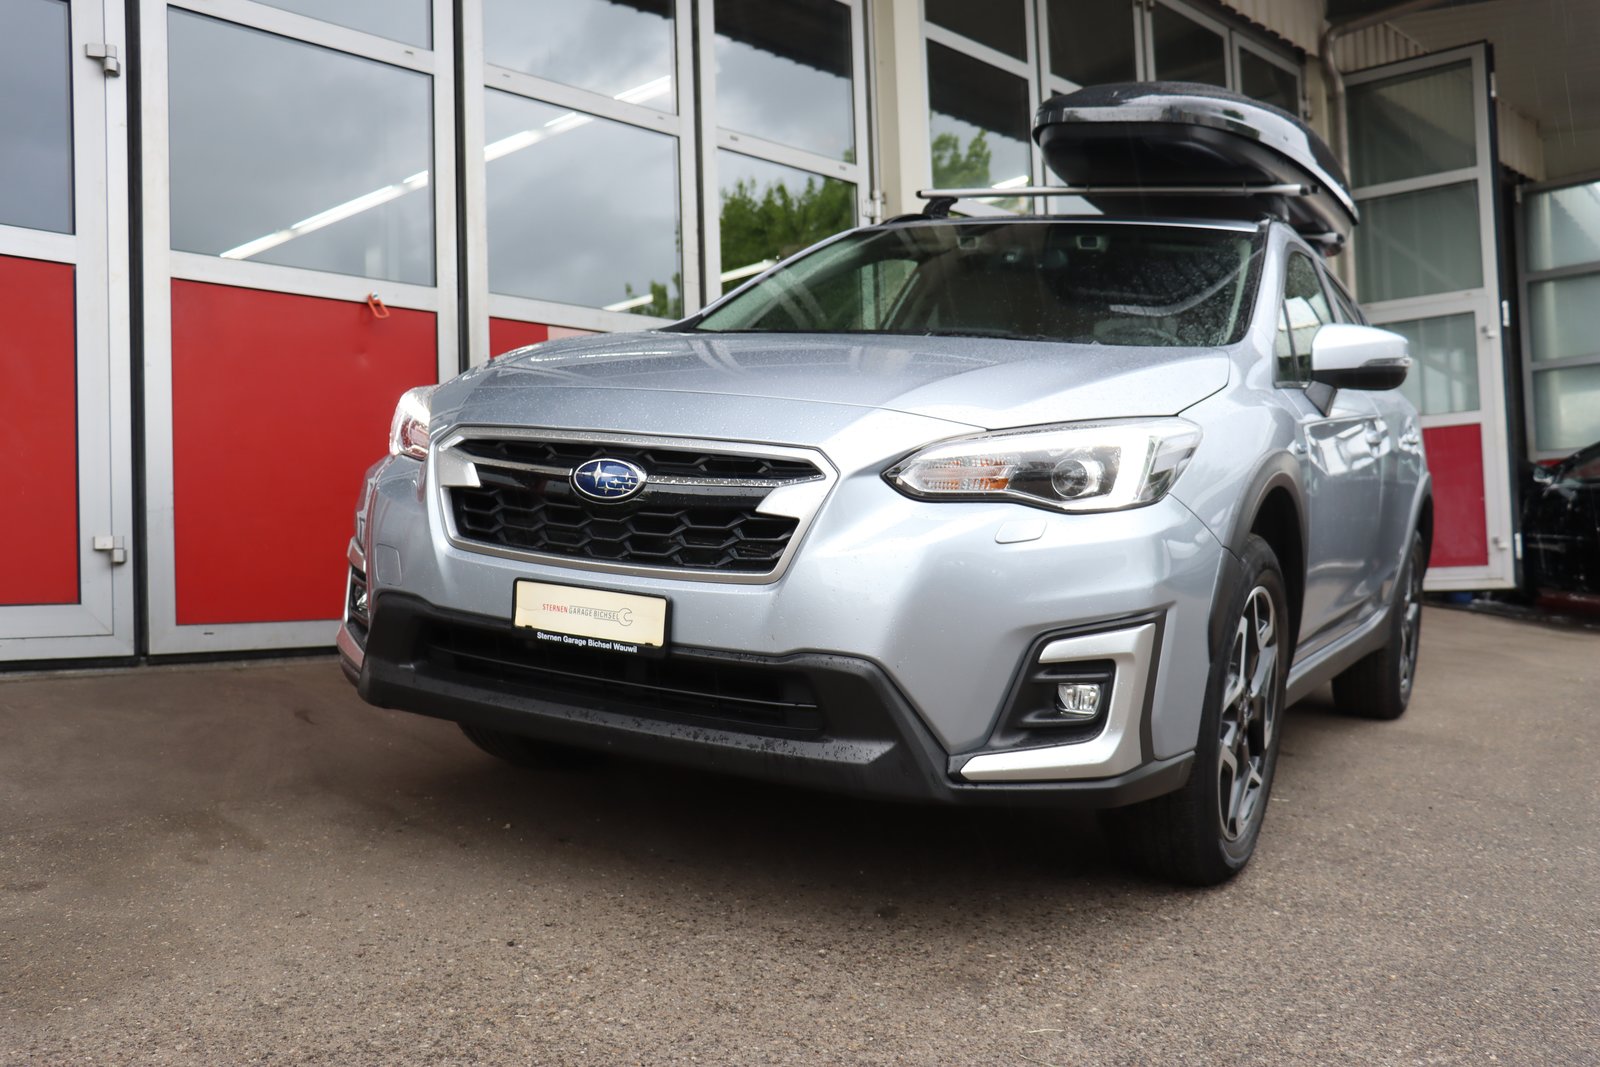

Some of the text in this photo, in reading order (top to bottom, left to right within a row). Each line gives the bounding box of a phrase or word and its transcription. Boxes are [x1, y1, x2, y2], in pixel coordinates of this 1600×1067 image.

[543, 604, 568, 613] STERNEN
[569, 607, 592, 616] GARAGE
[536, 632, 638, 653] Sternen Garage Bichsel Wauwil
